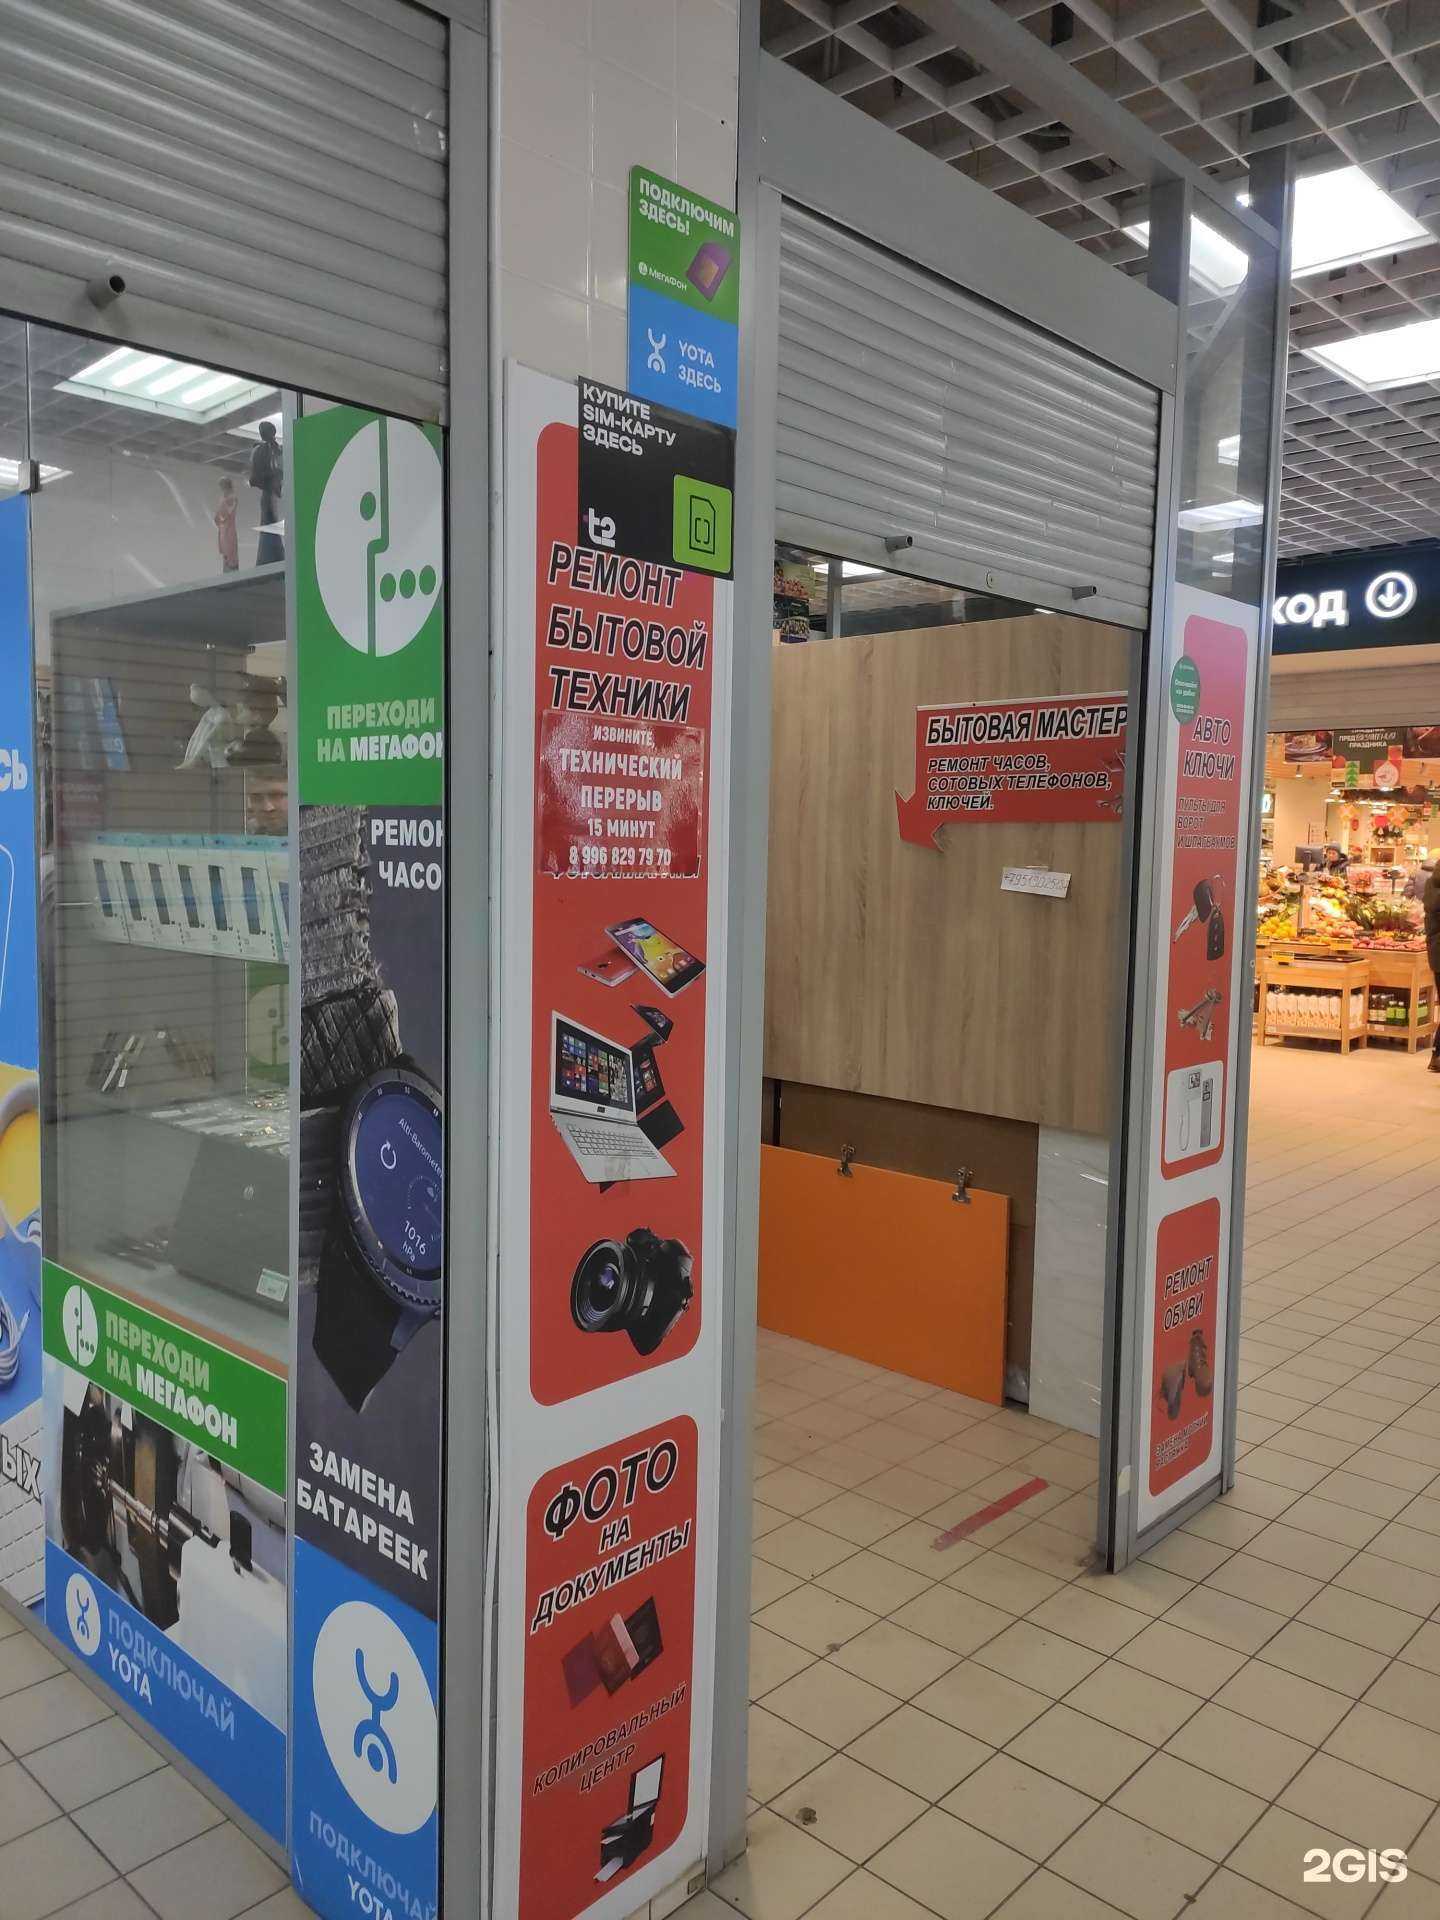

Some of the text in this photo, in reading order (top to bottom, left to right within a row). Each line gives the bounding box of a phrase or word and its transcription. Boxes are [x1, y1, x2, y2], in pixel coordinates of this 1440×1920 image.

[639, 178, 735, 238] ПОДКЛЮЧИМ
[639, 199, 690, 236] ЗДЕСЬ!
[678, 340, 714, 368] YOTA
[679, 364, 722, 393] ЗДЕСЬ
[583, 383, 650, 420] КУПИТЕ
[583, 404, 676, 446] SIM-КАРТУ
[583, 424, 643, 456] ЗДЕСЬ
[588, 508, 616, 548] t2
[547, 541, 683, 608] РЕМОНТ
[546, 604, 708, 671] БЫТОВОЙ
[549, 665, 691, 723] ТЕХНИКИ
[327, 698, 435, 730] ПЕРЕХОДИ
[925, 709, 1034, 746] БЫТОВАЯ
[1192, 715, 1231, 746] АВТО
[317, 738, 345, 762] НА
[592, 725, 655, 749] ИЗВИНИТЕ,
[559, 748, 682, 780] ТЕХНИЧЕСКИЙ
[927, 754, 1050, 773] РЕМОНТ ЧАСОВ,
[927, 772, 1112, 792] СОТОВЫХ ТЕЛЕФОНОВ,
[1183, 750, 1236, 781] КЛЮЧИ
[581, 785, 662, 812] ПЕРЕРЫВ
[927, 791, 993, 811] КЛЮЧЕЙ.
[588, 818, 655, 839] 15 МИНУТ
[1177, 816, 1205, 830] ВОРОТ
[569, 846, 671, 866] 8 996 829 79 70
[379, 861, 441, 890] ЧАСО
[402, 1241, 415, 1262] hPa
[403, 1220, 426, 1255] 1016
[1164, 1255, 1213, 1300] РЕМОНТ
[1163, 1291, 1204, 1331] ОБУВИ
[106, 1310, 209, 1392] ПЕРЕХОДИ
[106, 1347, 238, 1448] НА МЕГАФОН
[309, 1441, 415, 1525] ЗАМЕНА
[544, 1439, 678, 1542] ФОТО
[297, 1478, 428, 1581] БАТАРЕЕК
[599, 1515, 632, 1555] НА
[530, 1518, 692, 1635] ДОКУМЕНТЫ
[109, 1608, 235, 1741] ПОДКЛЮЧАЙ
[109, 1644, 152, 1705] YOTA
[533, 1680, 687, 1797] КОПИРОВАЛЬНЫЙ
[579, 1744, 635, 1795] ЦЕНТР
[348, 1873, 393, 1920] YOTA
